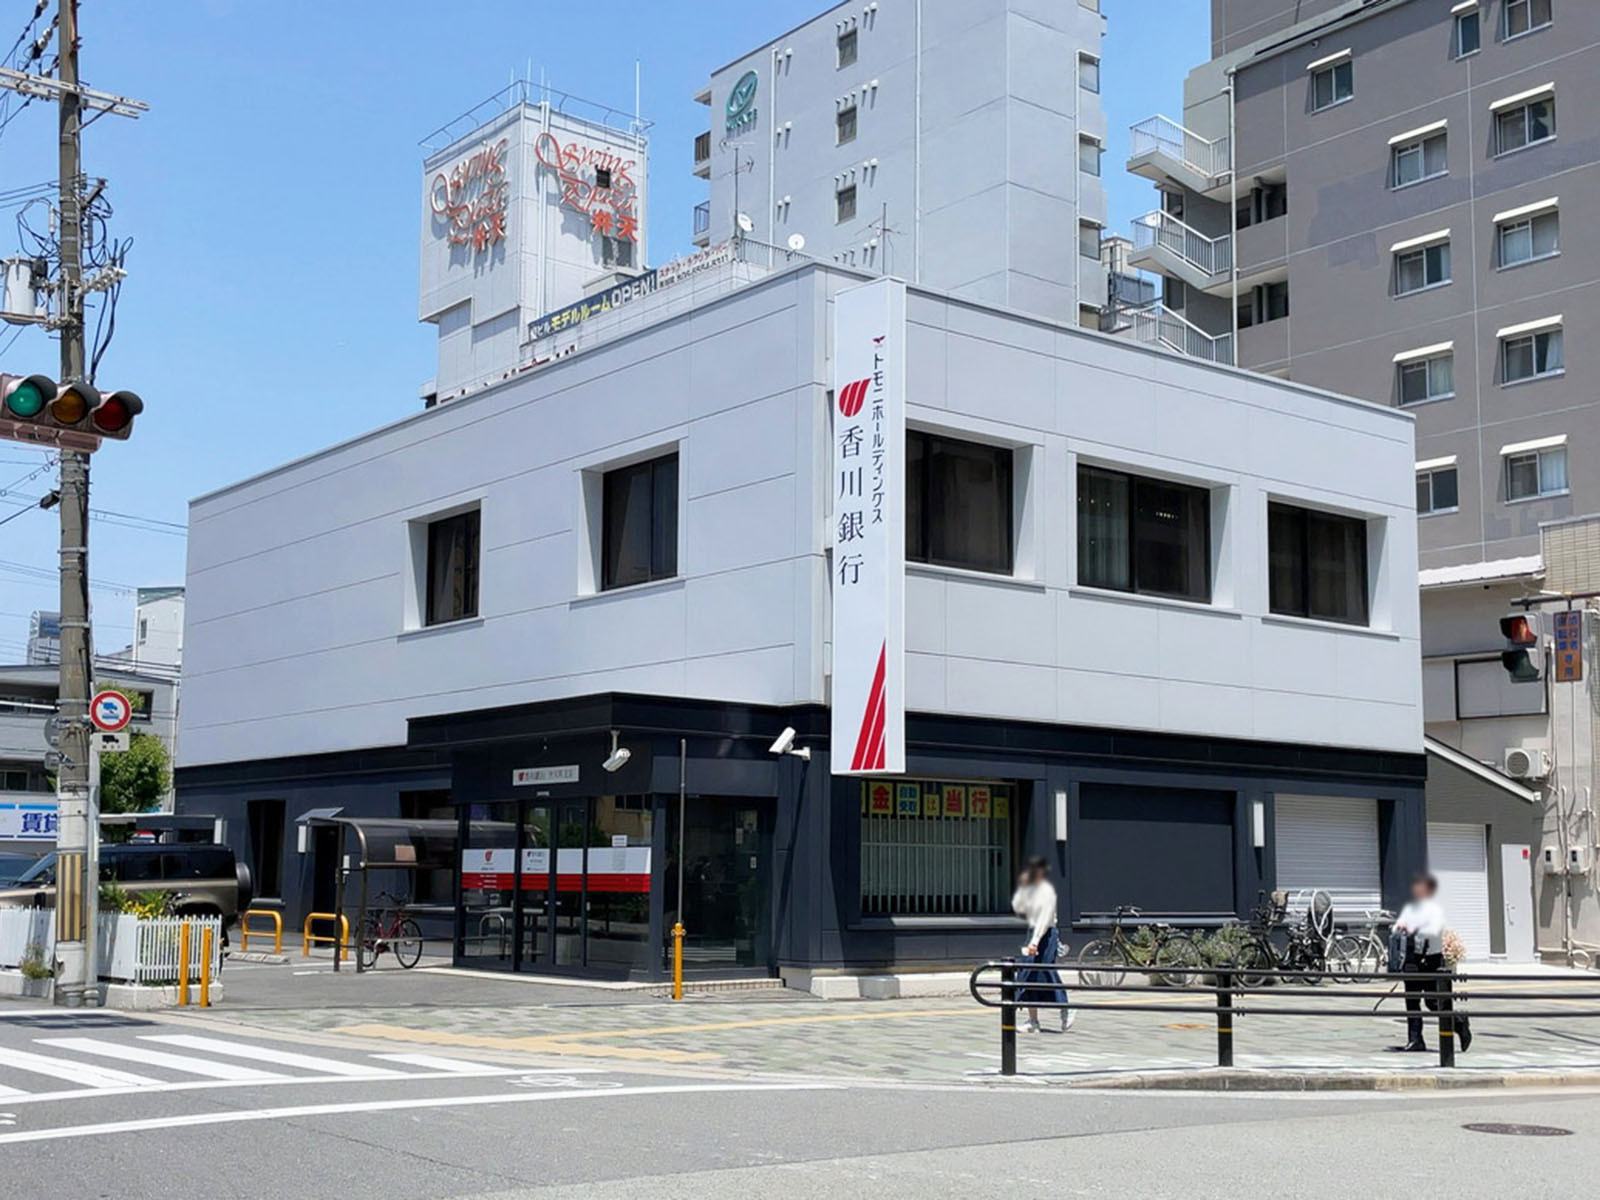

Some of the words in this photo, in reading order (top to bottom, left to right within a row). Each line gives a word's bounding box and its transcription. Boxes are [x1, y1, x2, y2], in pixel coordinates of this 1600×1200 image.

[838, 425, 865, 586] 香川銀行
[872, 352, 886, 524] トモニホールディングス
